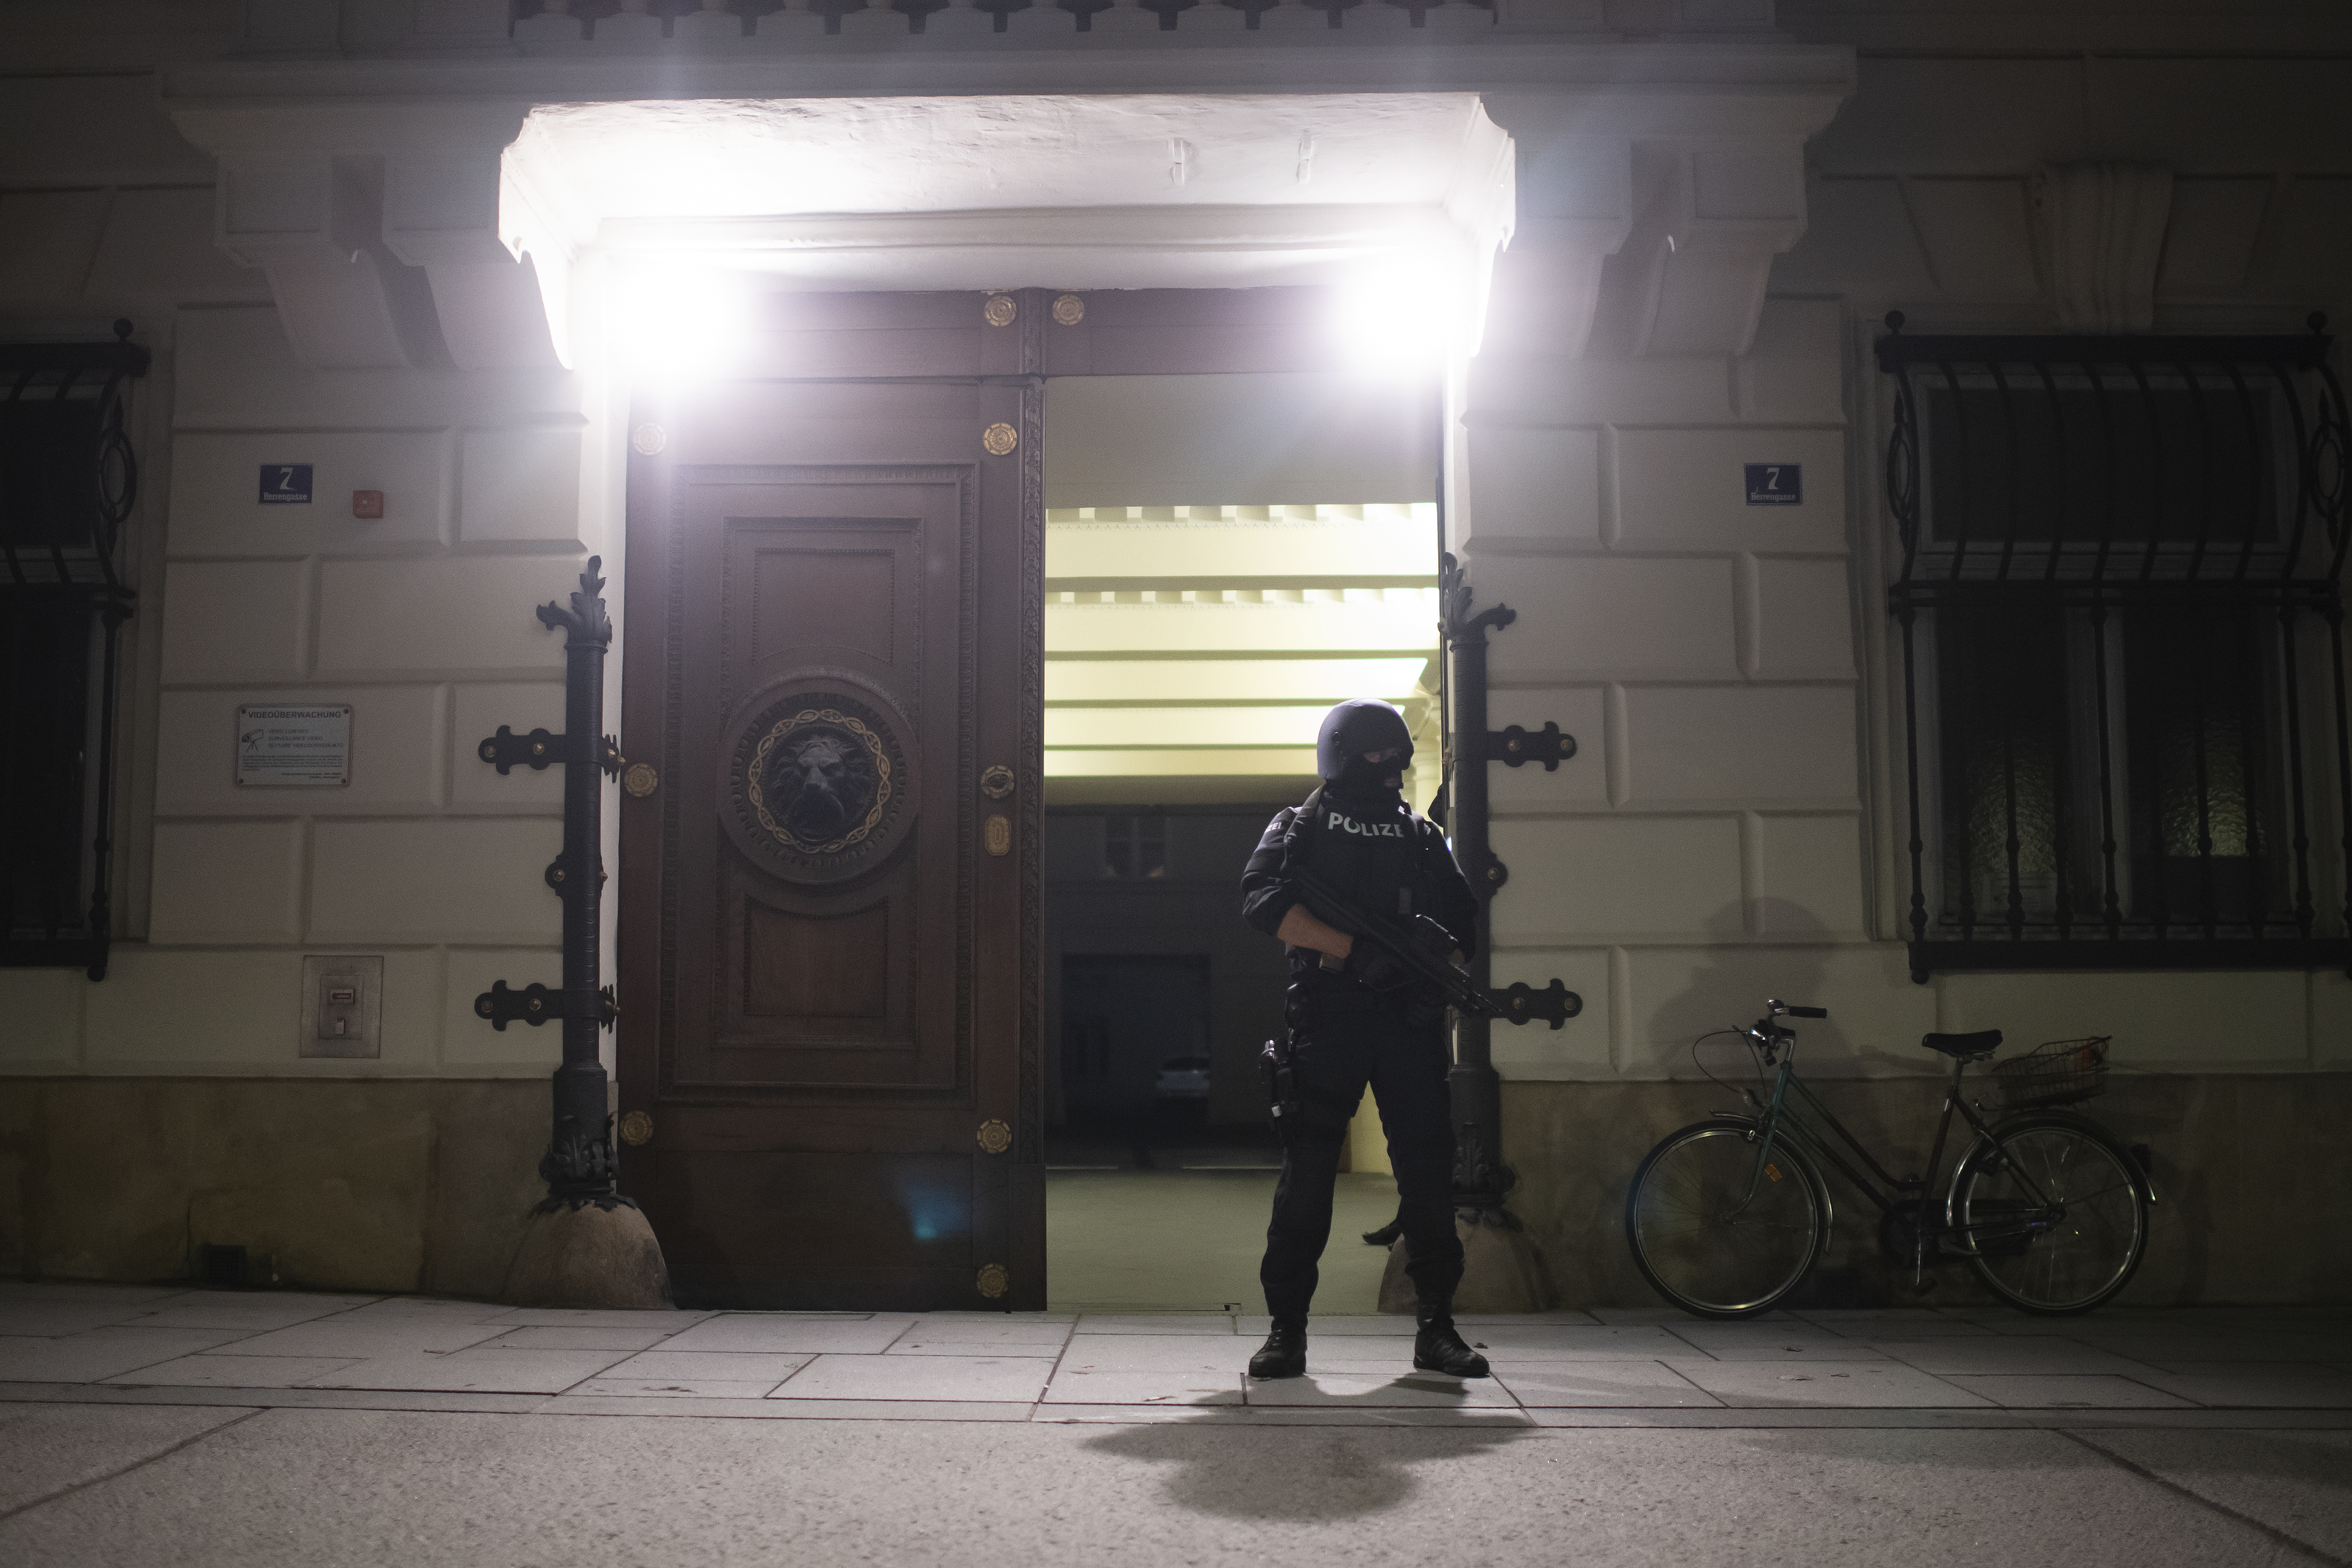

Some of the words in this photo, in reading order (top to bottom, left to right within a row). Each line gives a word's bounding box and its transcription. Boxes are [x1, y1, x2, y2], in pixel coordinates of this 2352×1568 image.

[280, 467, 295, 490] 7
[1766, 467, 1780, 490] 7
[263, 492, 308, 502] Herrengasse
[1750, 492, 1796, 502] Herrengasse
[248, 710, 342, 718] VIDEOÜBERWACHUNG
[1328, 812, 1404, 838] POLIZE
